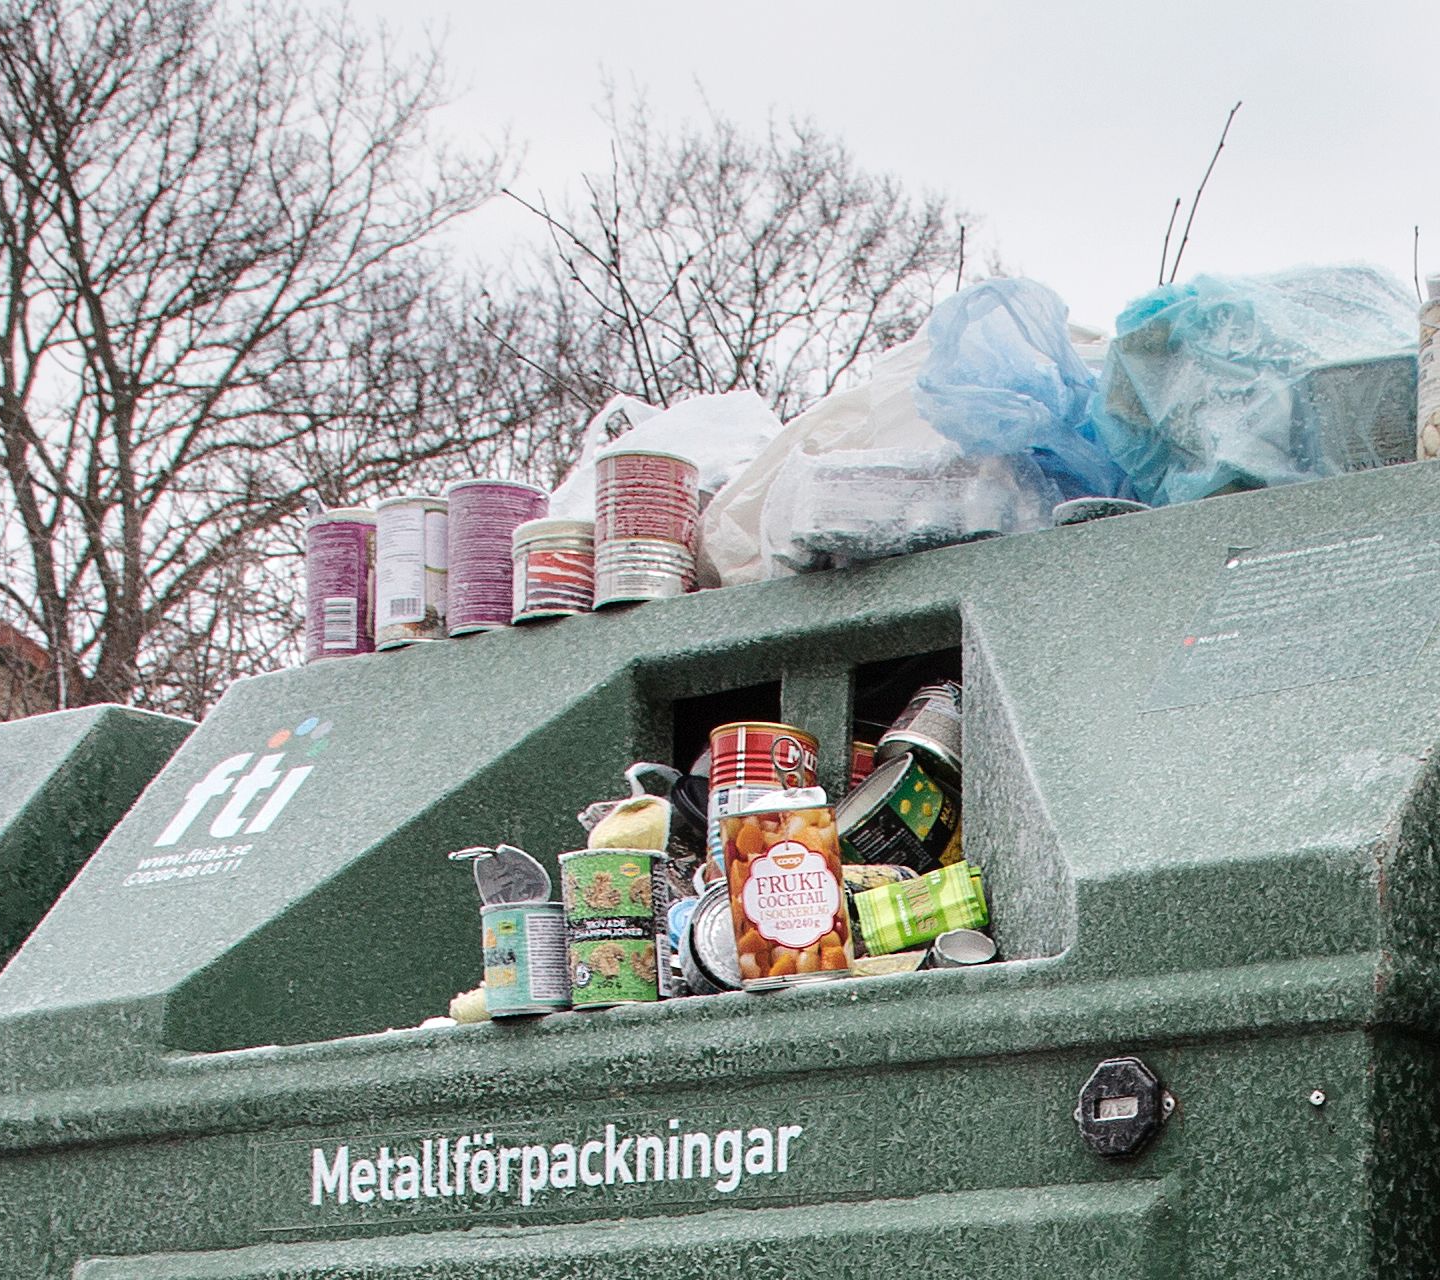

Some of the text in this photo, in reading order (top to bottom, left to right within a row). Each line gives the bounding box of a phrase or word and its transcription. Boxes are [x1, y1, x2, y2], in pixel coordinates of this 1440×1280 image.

[153, 752, 315, 847] fti
[758, 892, 827, 909] COCKTAIL
[310, 1118, 803, 1206] Metallförpackningar
